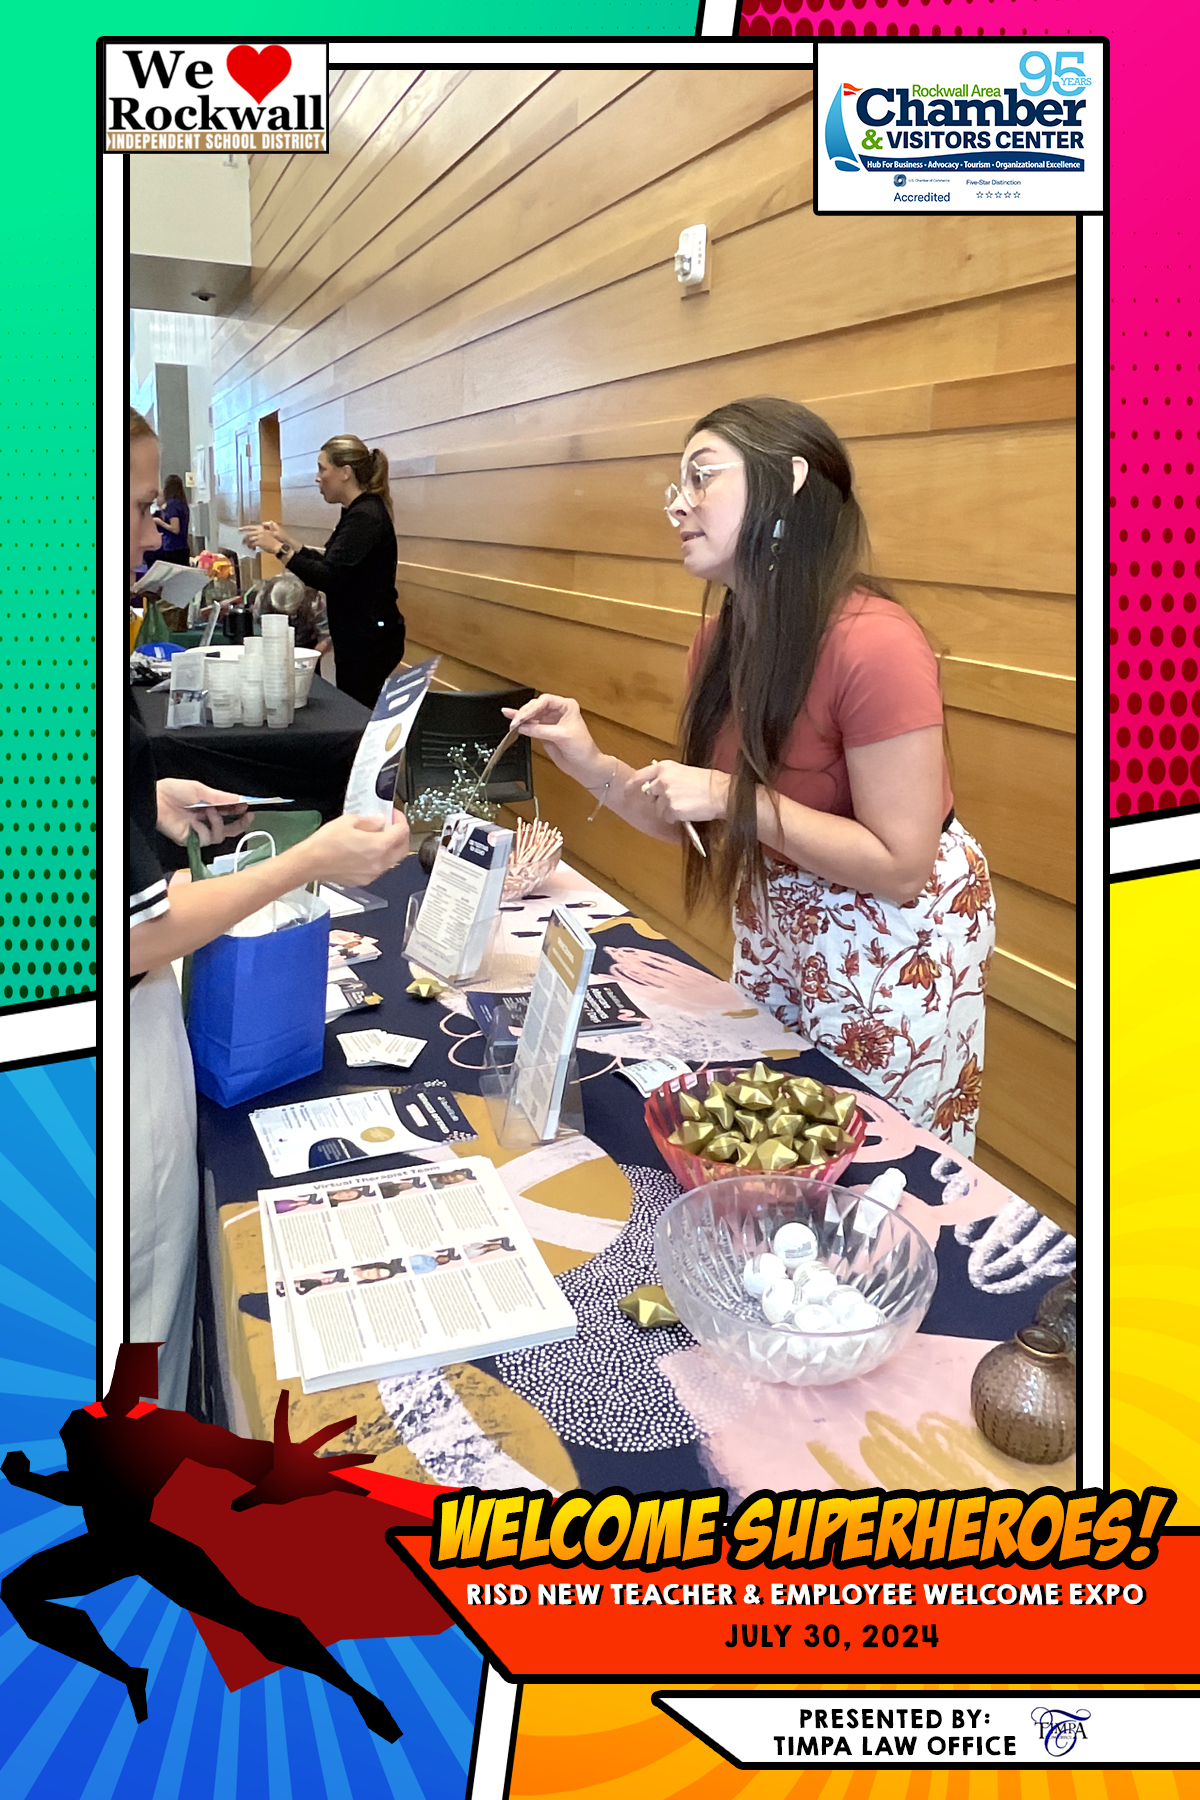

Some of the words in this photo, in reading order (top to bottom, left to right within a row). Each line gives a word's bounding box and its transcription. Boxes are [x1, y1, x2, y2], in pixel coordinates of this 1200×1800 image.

[313, 1179, 353, 1190] Virtual
[354, 1171, 409, 1184] Therapist
[410, 1165, 441, 1175] Team
